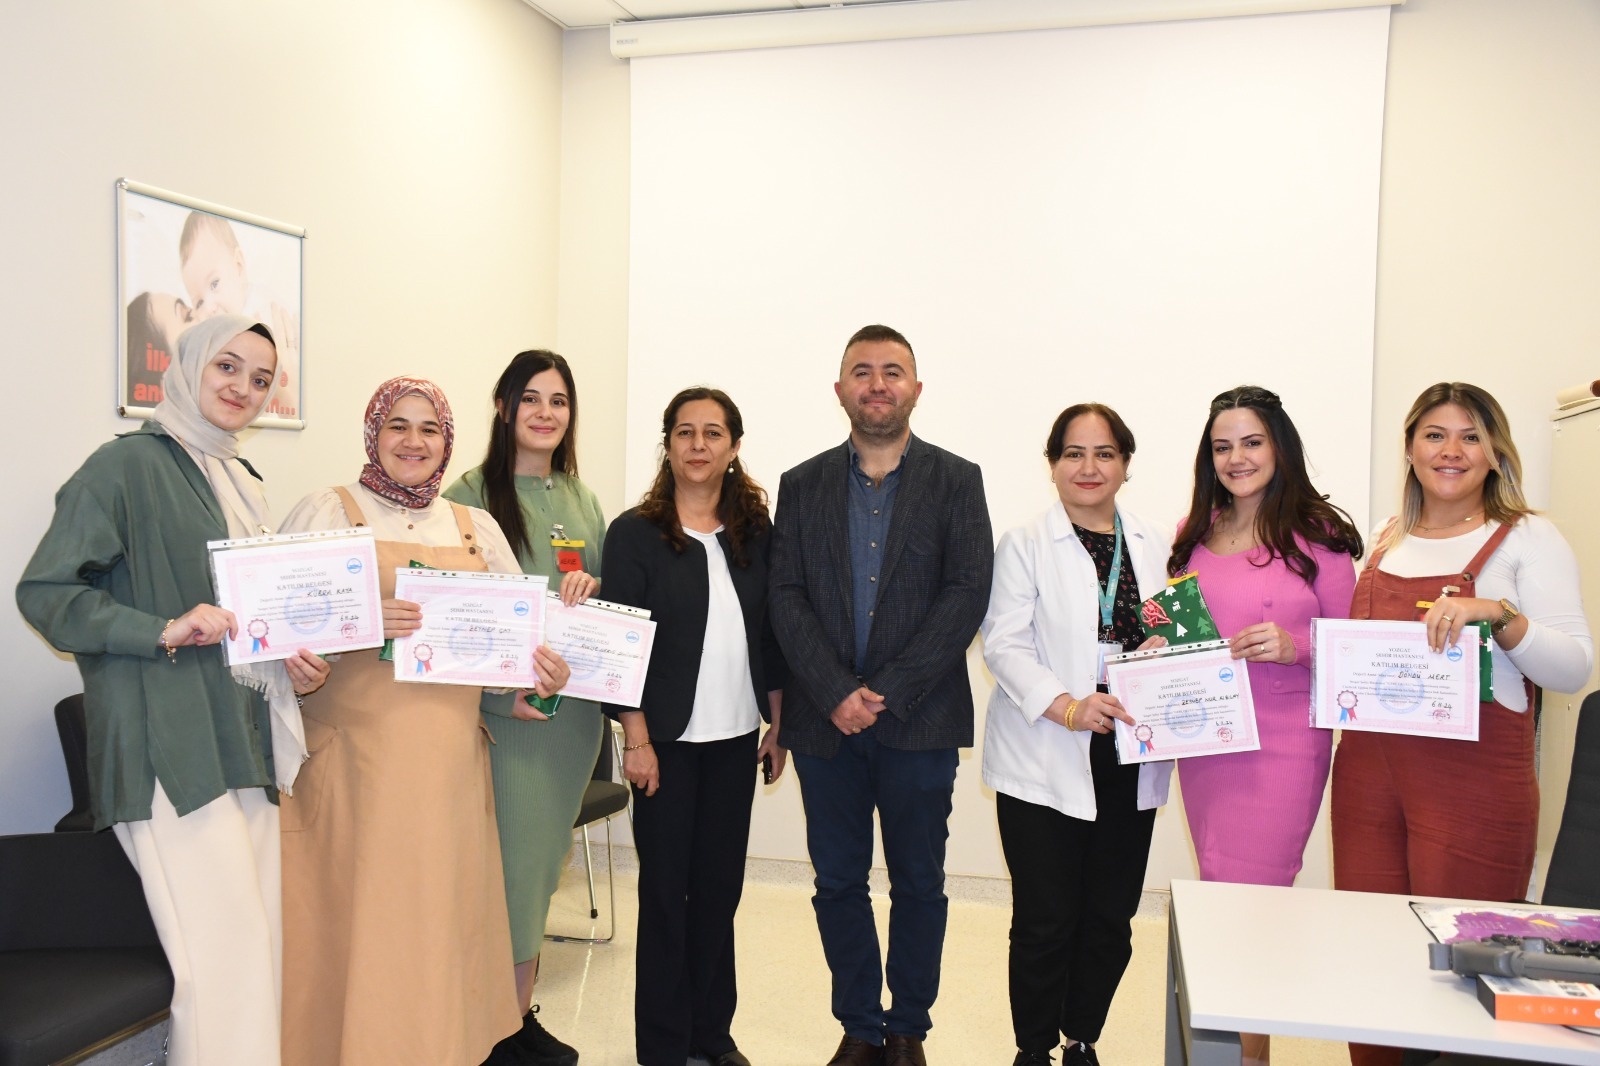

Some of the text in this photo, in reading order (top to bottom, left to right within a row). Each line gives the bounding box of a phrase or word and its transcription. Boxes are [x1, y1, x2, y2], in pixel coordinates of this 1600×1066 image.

[1400, 662, 1429, 670] BELGESİ
[1397, 669, 1421, 678] DÖNDÜ
[1427, 673, 1452, 681] MERT
